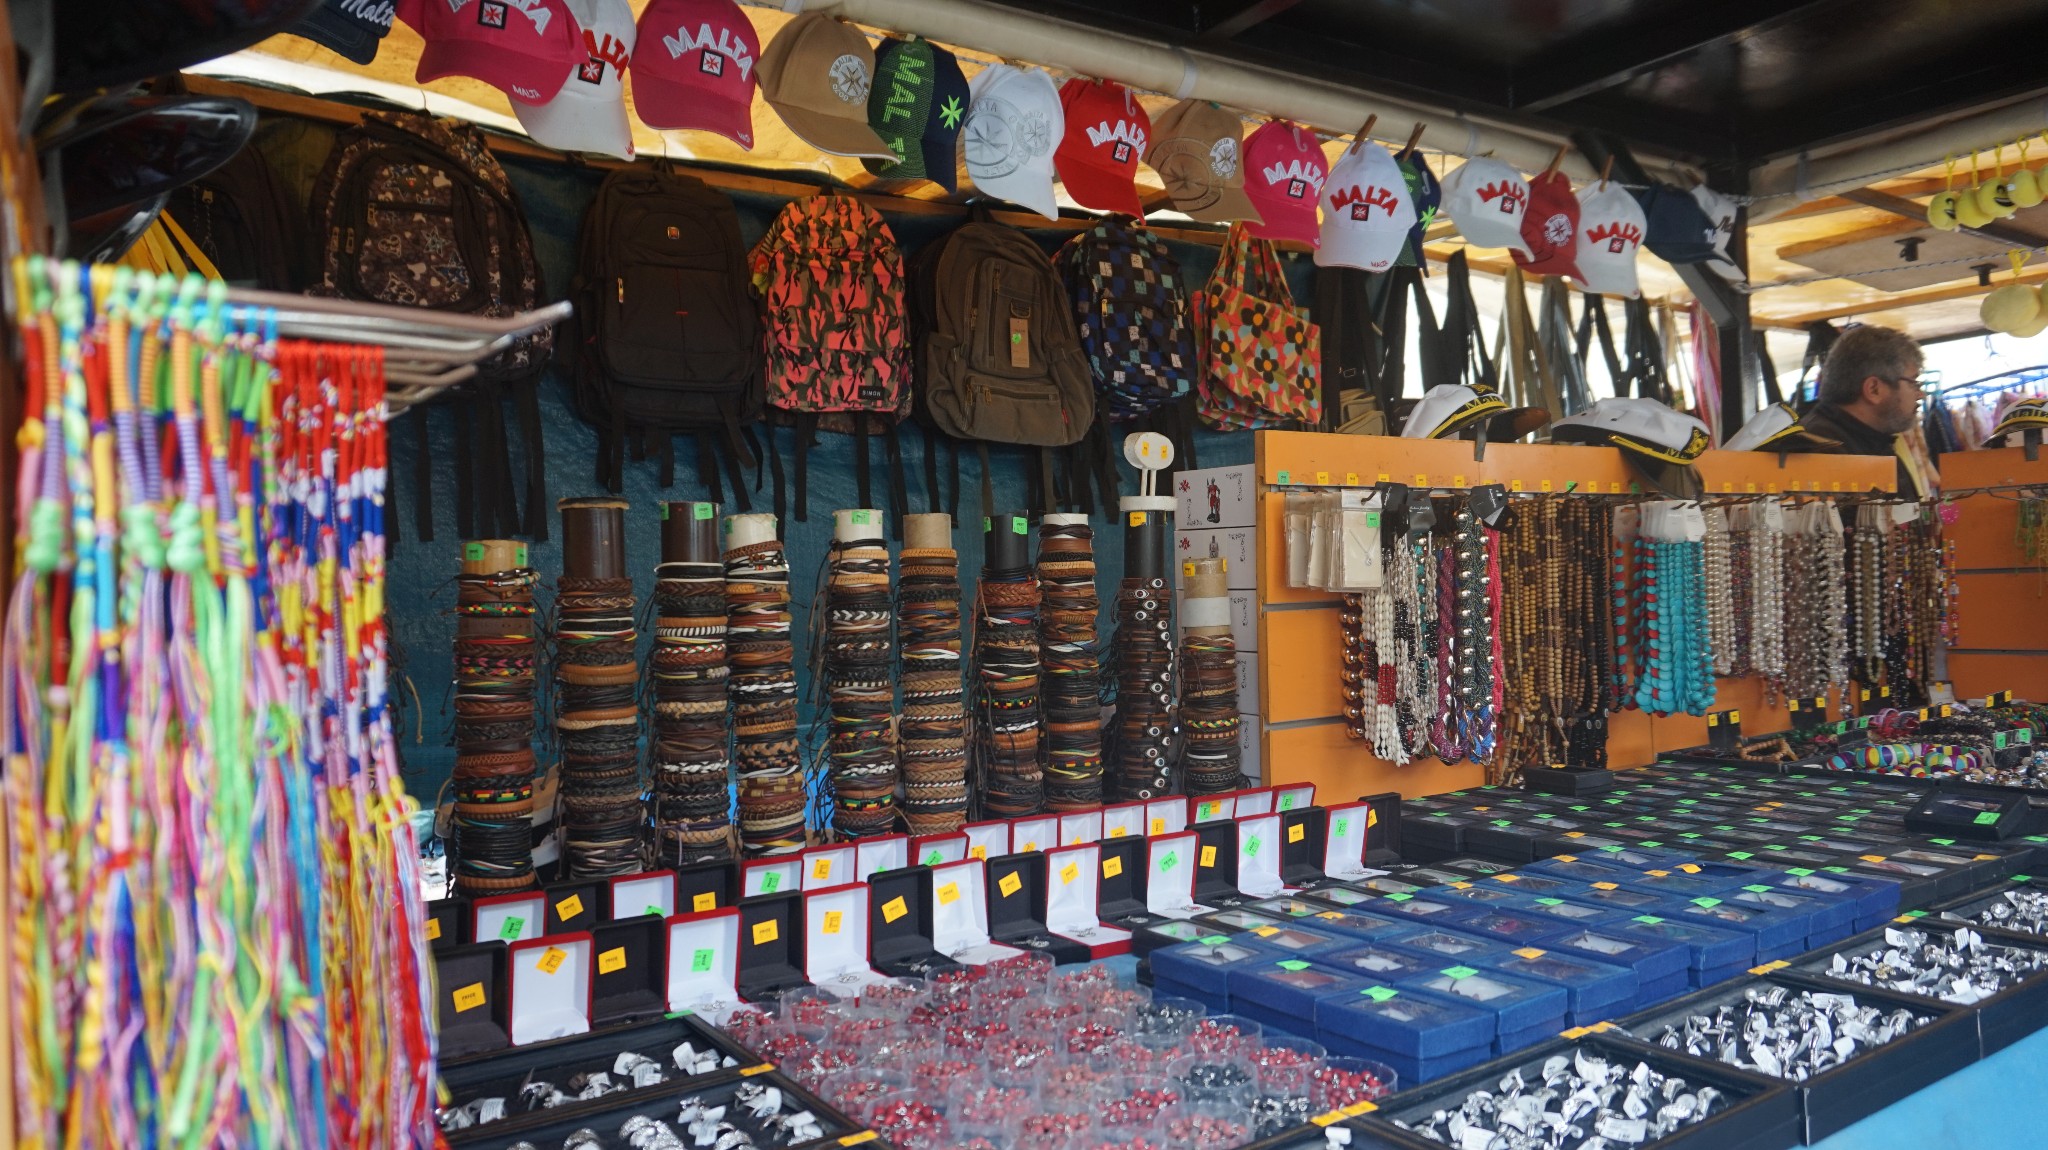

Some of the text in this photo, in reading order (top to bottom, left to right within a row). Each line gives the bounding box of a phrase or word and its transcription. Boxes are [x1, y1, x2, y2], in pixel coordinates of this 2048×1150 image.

[582, 29, 630, 82] ALTA
[662, 23, 753, 82] MALTA
[513, 85, 541, 98] MALTA
[1086, 120, 1147, 162] MALTA
[1263, 160, 1324, 197] MALTA
[1330, 185, 1399, 218] MALTA
[1476, 179, 1527, 215] MALTA
[1585, 222, 1642, 250] MALTA
[1371, 260, 1389, 269] MALTA
